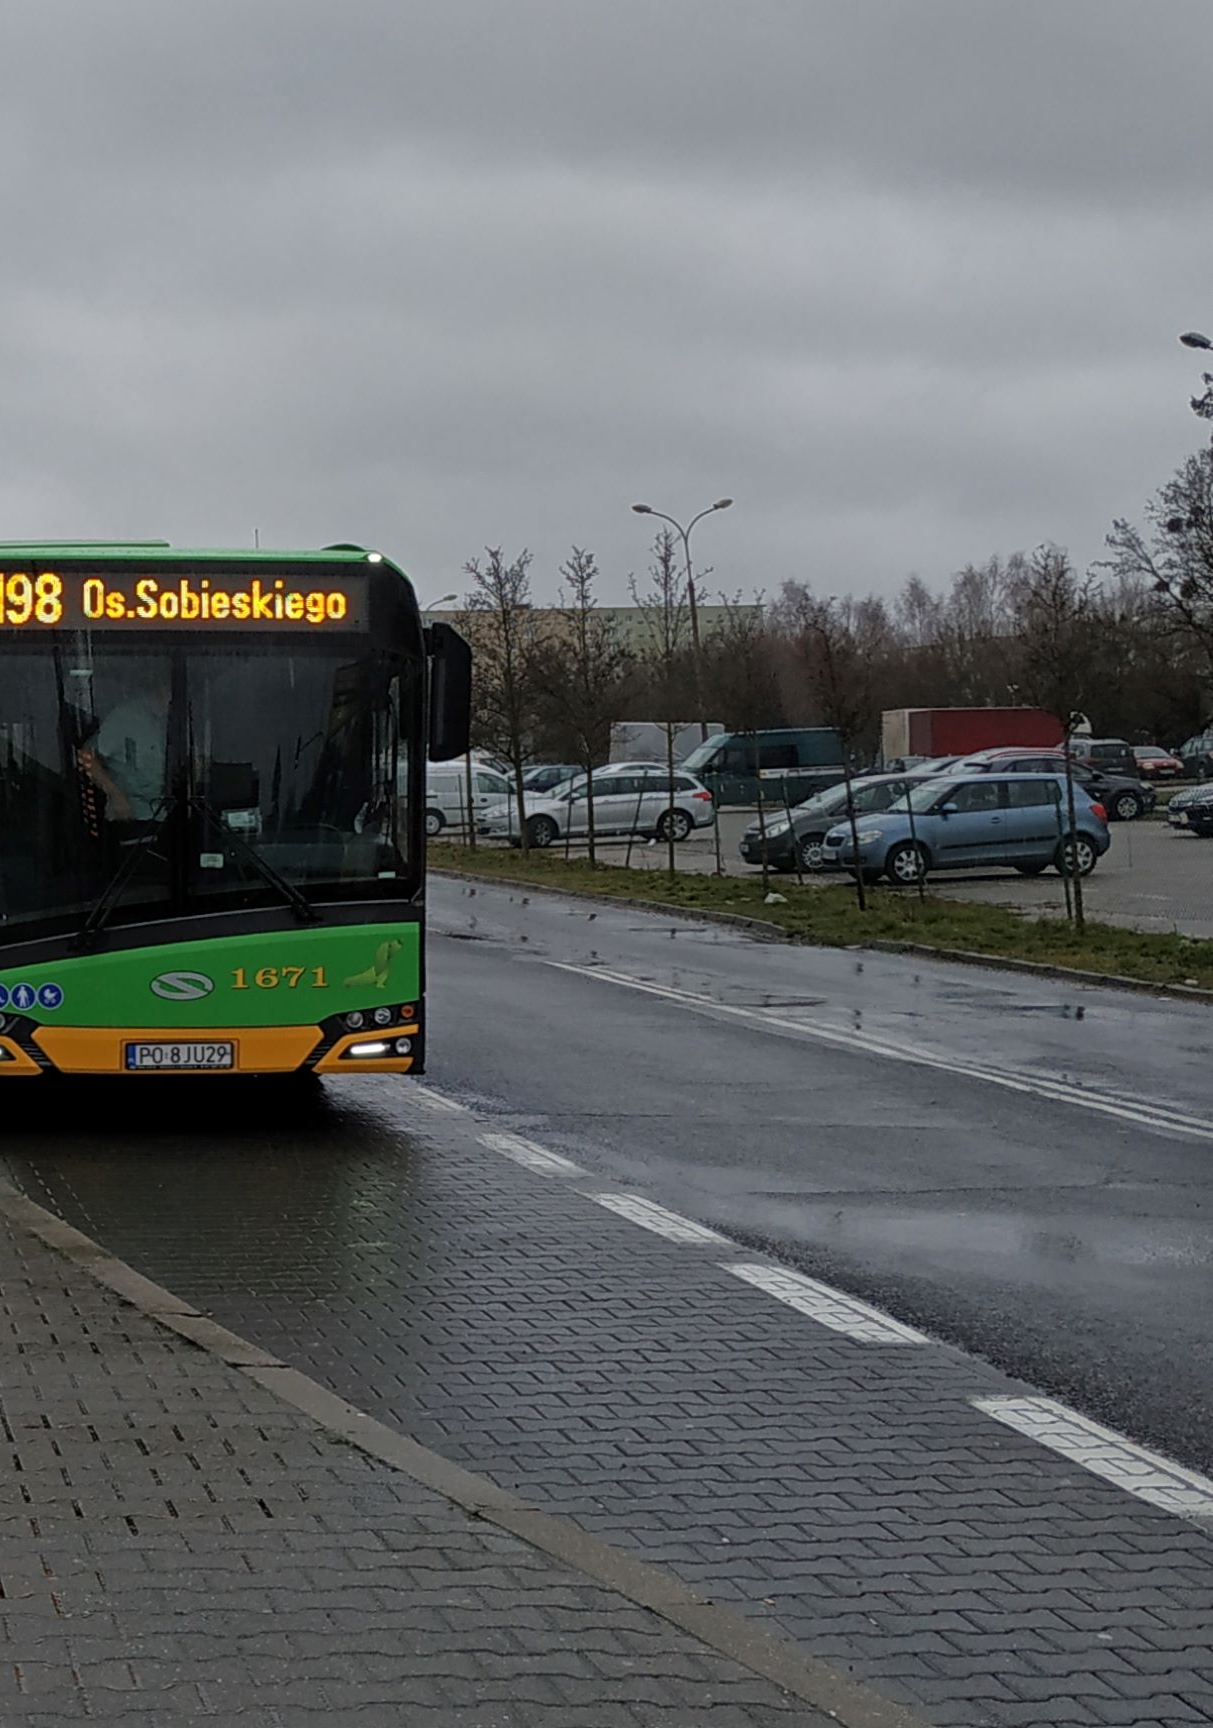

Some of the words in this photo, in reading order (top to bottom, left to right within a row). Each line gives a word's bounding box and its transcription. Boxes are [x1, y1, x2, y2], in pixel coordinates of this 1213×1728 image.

[83, 579, 347, 624] Os.Sobieskiego
[230, 967, 329, 989] 1671
[139, 1046, 163, 1064] PO
[170, 1045, 227, 1063] 8JU29
